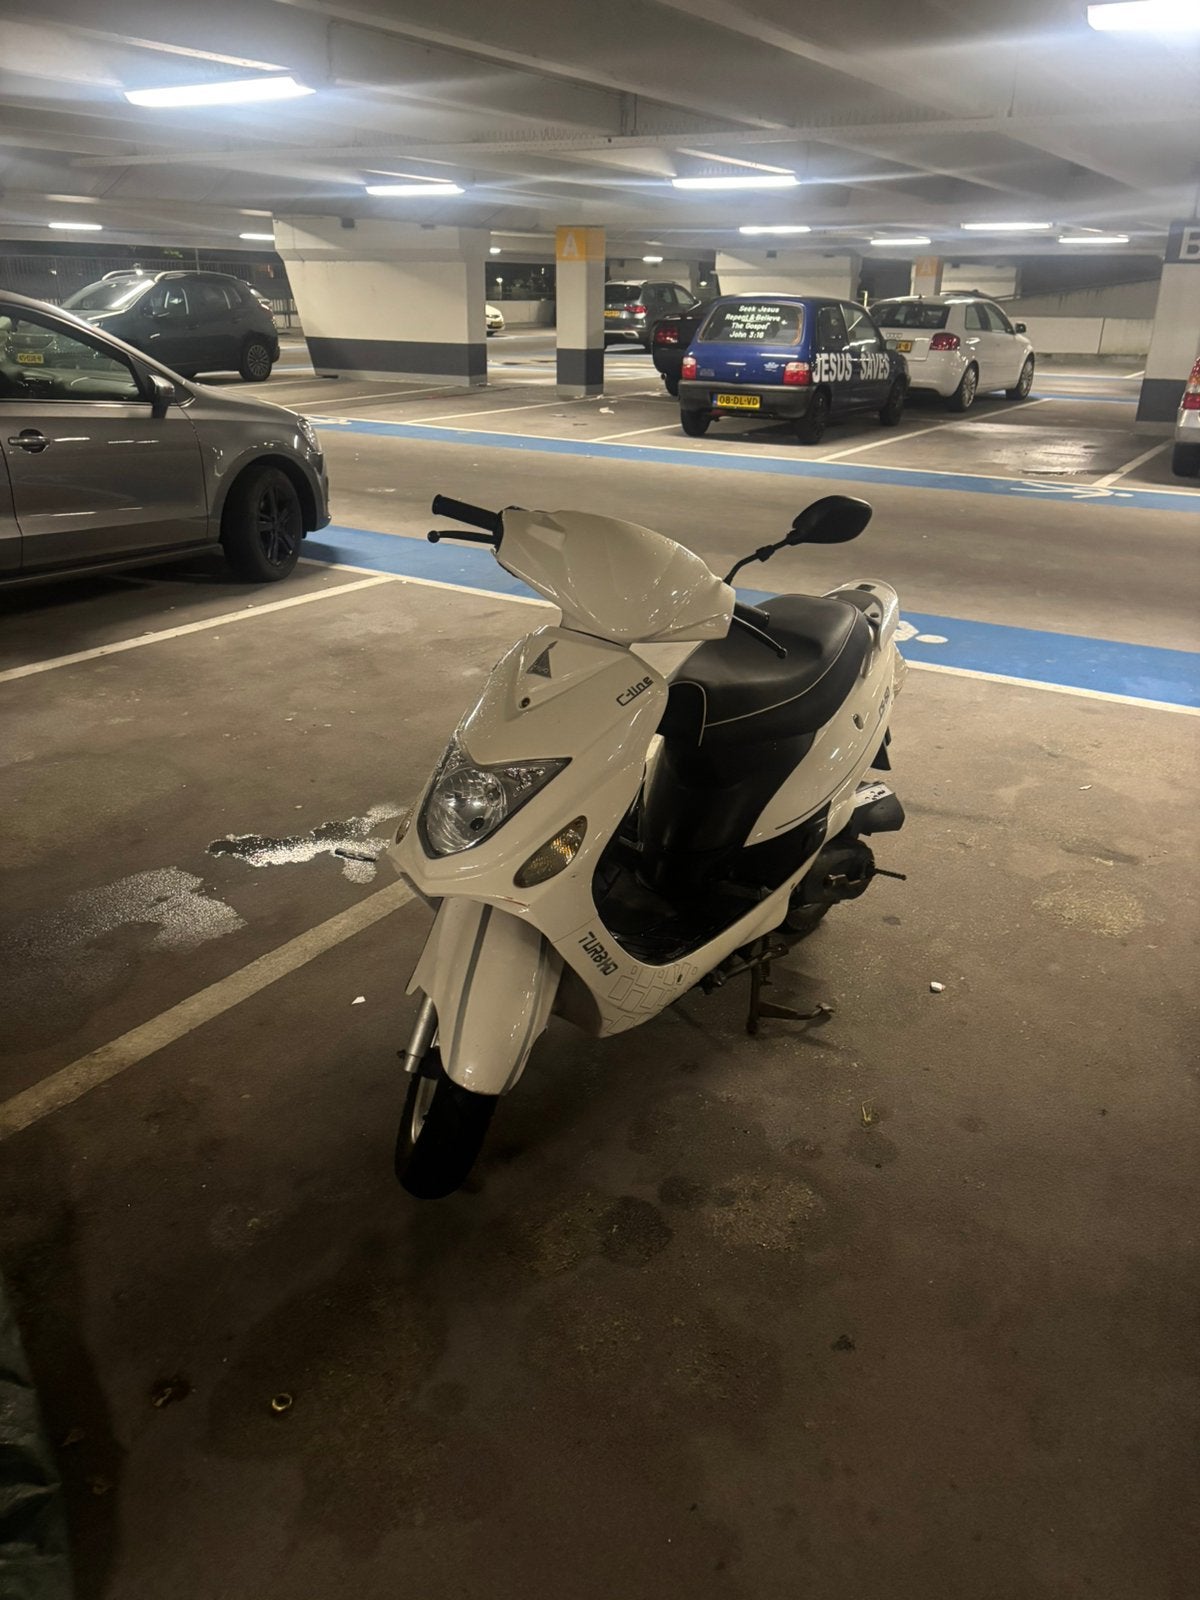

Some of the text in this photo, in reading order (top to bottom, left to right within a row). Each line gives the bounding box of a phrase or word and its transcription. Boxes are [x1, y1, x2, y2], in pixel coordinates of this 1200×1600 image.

[562, 231, 578, 256] A
[757, 305, 780, 313] Jesus
[725, 313, 749, 321] Repent
[755, 314, 781, 322] Believe
[745, 322, 771, 331] Gospel
[729, 330, 747, 338] John
[812, 351, 890, 383] JESUS SAVES
[718, 394, 759, 406] 08-DL-VD
[578, 931, 619, 976] TURBHO
